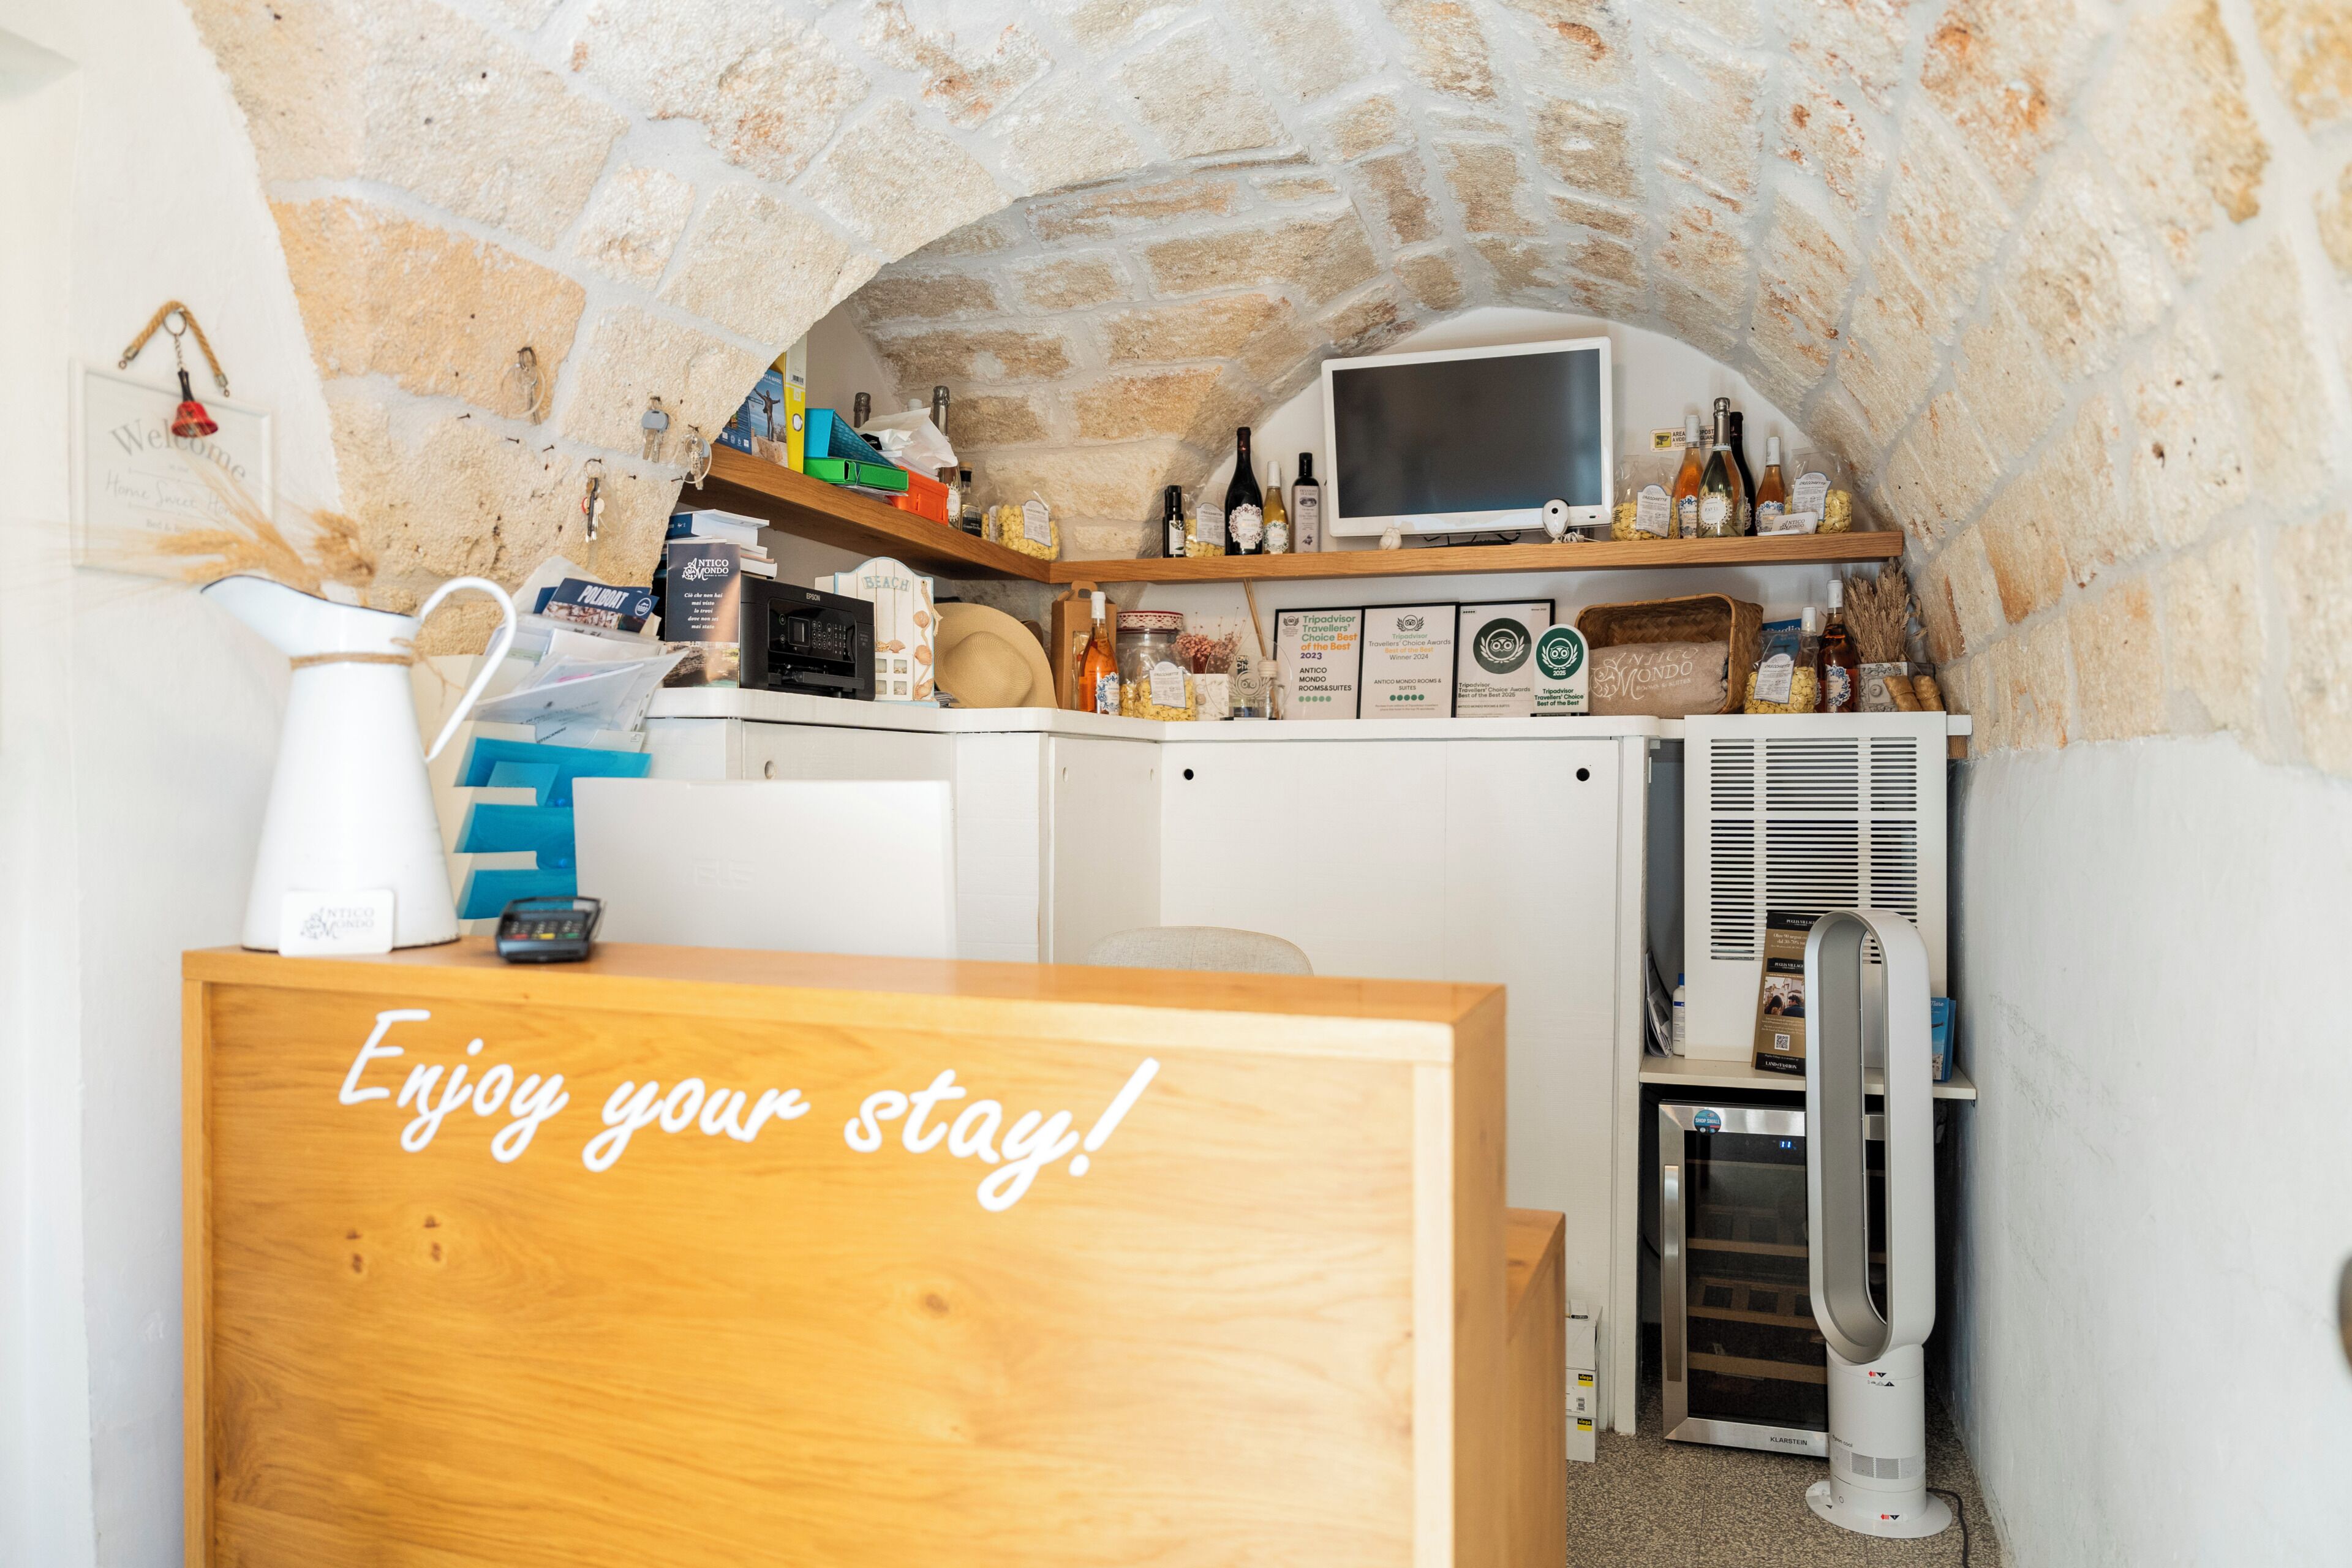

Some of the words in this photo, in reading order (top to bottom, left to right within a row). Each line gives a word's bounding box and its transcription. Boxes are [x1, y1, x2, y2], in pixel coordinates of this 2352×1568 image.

[108, 418, 246, 482] Welcome
[687, 557, 729, 568] ANTICO
[695, 567, 729, 581] MONDO
[864, 576, 909, 592] BEACH
[577, 585, 629, 609] POLIBOAT
[806, 592, 820, 601] EPSON
[1303, 614, 1356, 625] Tripadvisor
[1302, 624, 1351, 633] Travellers'
[1603, 647, 1698, 673] ANTICO
[1621, 661, 1692, 700] MONDO
[339, 1009, 569, 1163] Enjoy
[582, 1077, 811, 1172] your
[844, 1057, 1161, 1212] stay!
[1770, 1436, 1807, 1446] KLARSTEIN
